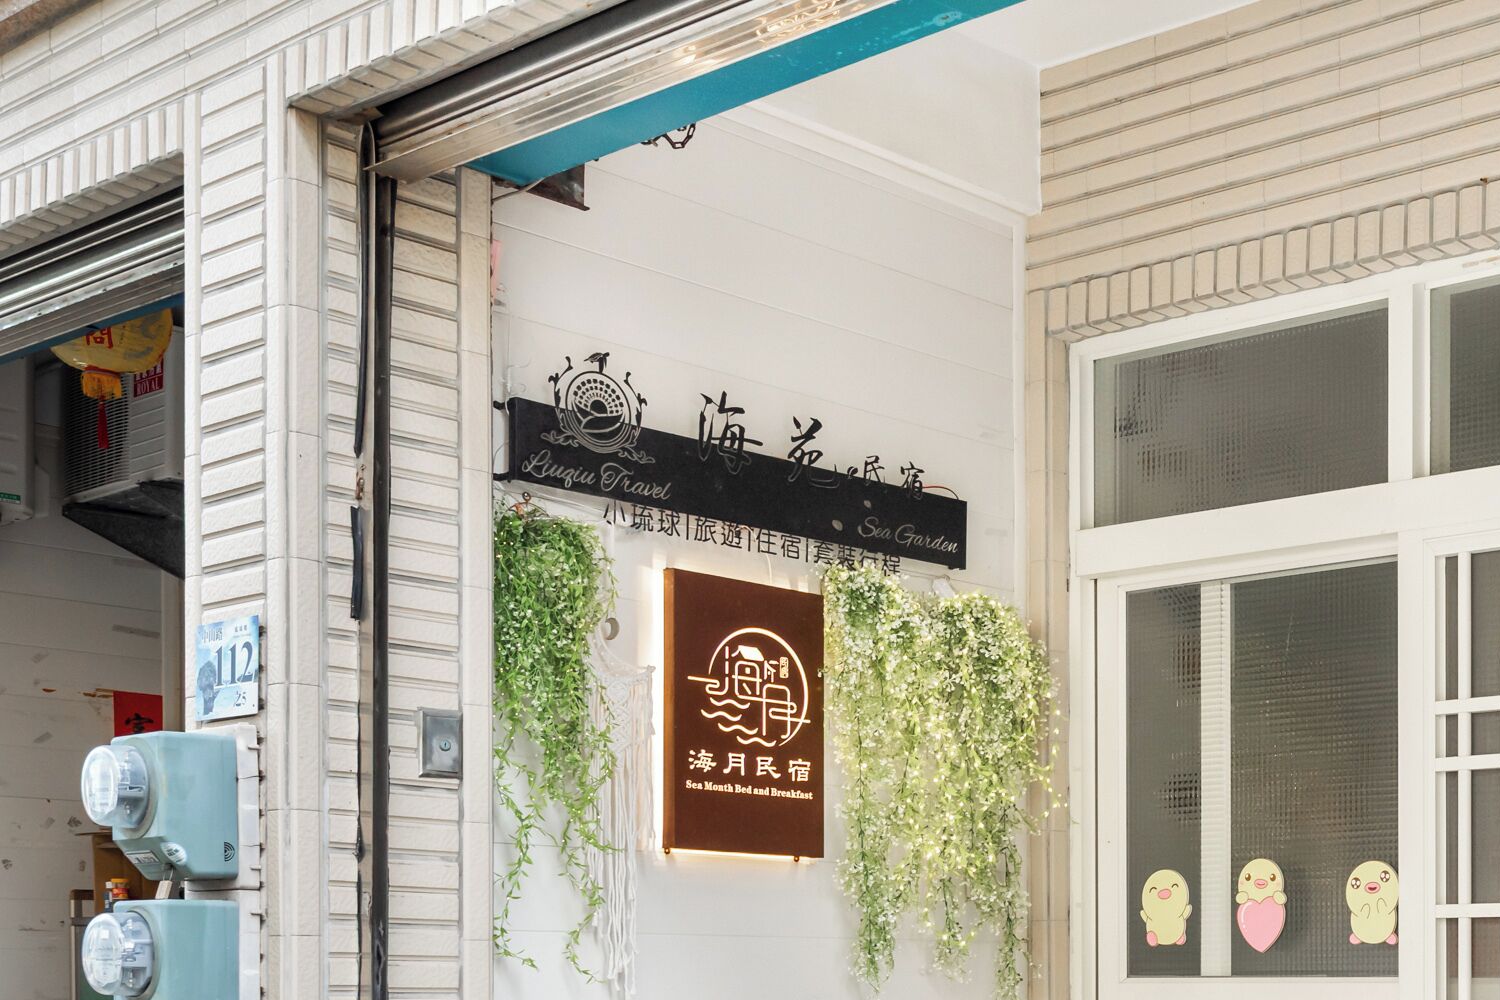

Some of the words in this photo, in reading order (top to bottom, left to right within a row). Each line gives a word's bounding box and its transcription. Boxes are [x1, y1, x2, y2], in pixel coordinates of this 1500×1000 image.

[136, 377, 161, 394] ROYAL
[522, 449, 596, 488] Liuqiu
[600, 462, 672, 500] Travel
[857, 516, 893, 539] Sea
[895, 524, 959, 553] Garden
[215, 641, 254, 687] 112
[688, 748, 812, 782] 海月民宿
[685, 779, 703, 790] Sea
[703, 781, 734, 793] Month
[735, 784, 752, 795] Bed
[753, 786, 769, 796] and
[770, 787, 814, 800] Breakfast
